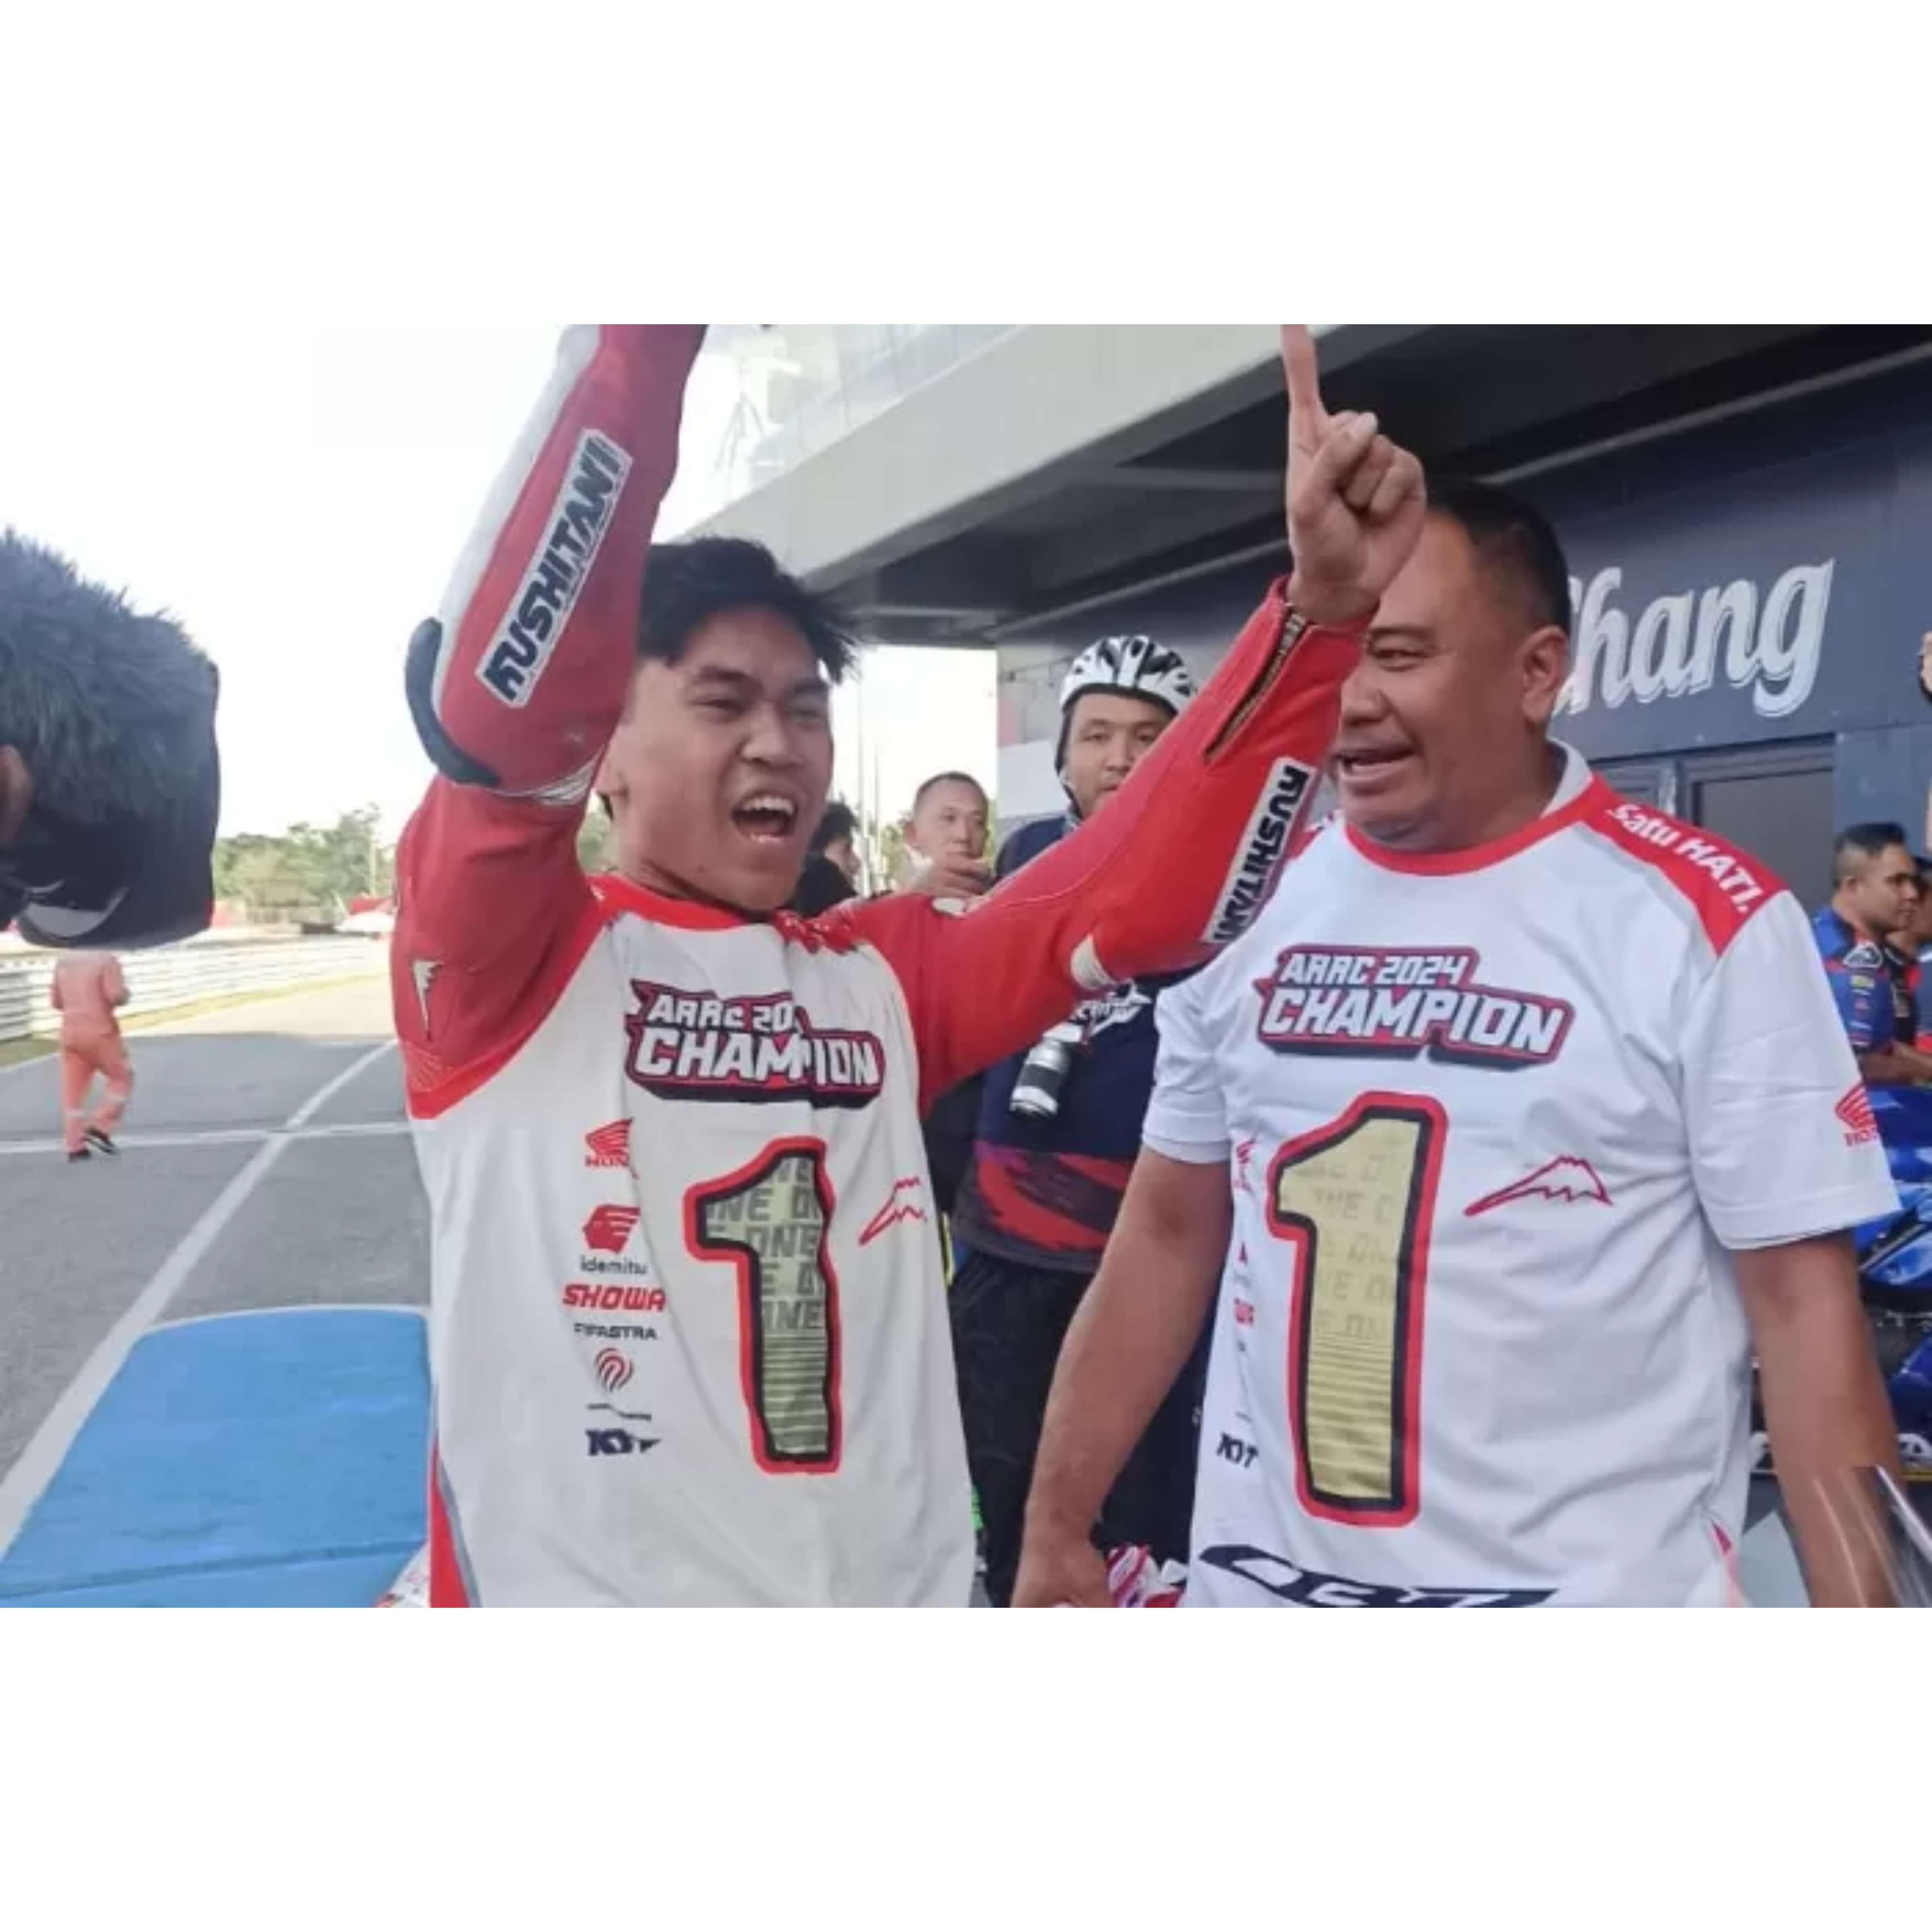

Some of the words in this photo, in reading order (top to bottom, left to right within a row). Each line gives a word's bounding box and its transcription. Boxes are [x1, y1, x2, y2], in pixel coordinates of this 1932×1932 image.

[1553, 559, 1835, 716] hang
[1259, 987, 1565, 1054] CHAMPION
[1280, 953, 1374, 985] ARRC
[1374, 953, 1470, 986] 2024
[562, 1283, 666, 1312] SHOWA
[682, 1135, 843, 1475] 1
[1266, 1090, 1449, 1529] 1
